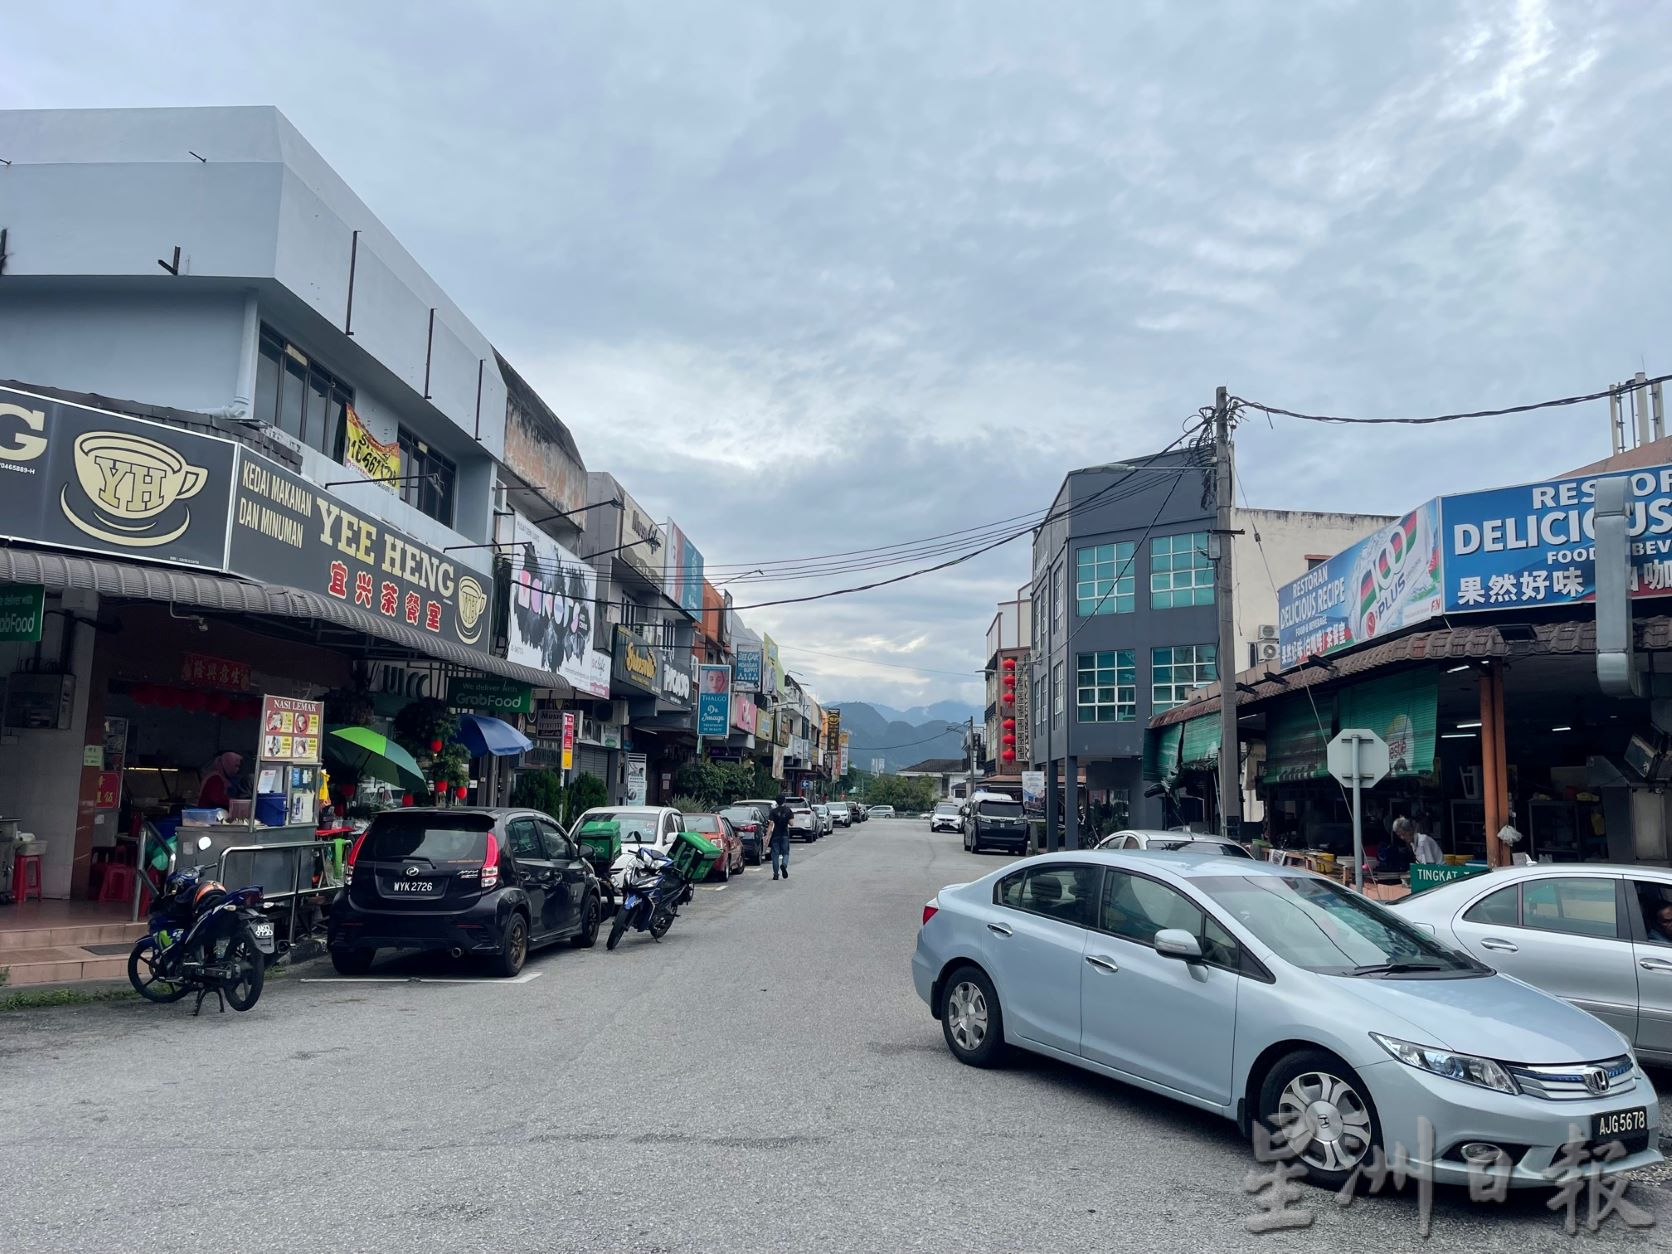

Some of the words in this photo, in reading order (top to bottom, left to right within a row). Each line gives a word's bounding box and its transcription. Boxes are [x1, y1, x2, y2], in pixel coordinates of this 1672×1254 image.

[94, 455, 167, 513] YH
[242, 460, 271, 499] KEDAI
[271, 476, 312, 518] MAKANAN
[239, 498, 259, 532] DAN
[260, 508, 304, 549] MINUMAN
[316, 497, 377, 566] YEE
[381, 532, 455, 598] HENG
[1292, 565, 1328, 599] RESTORAN
[1378, 572, 1406, 621] PLUS
[1457, 566, 1585, 606] 果然好味
[1280, 591, 1316, 630] DELICIOUS
[1317, 576, 1345, 613] RECIPE
[273, 699, 292, 710] NASI
[292, 701, 316, 712] LEMAK
[455, 692, 522, 708] GrabFood
[701, 694, 727, 702] THALGO
[1417, 869, 1458, 881] TINGKAT
[1599, 1111, 1645, 1136] AJG5678
